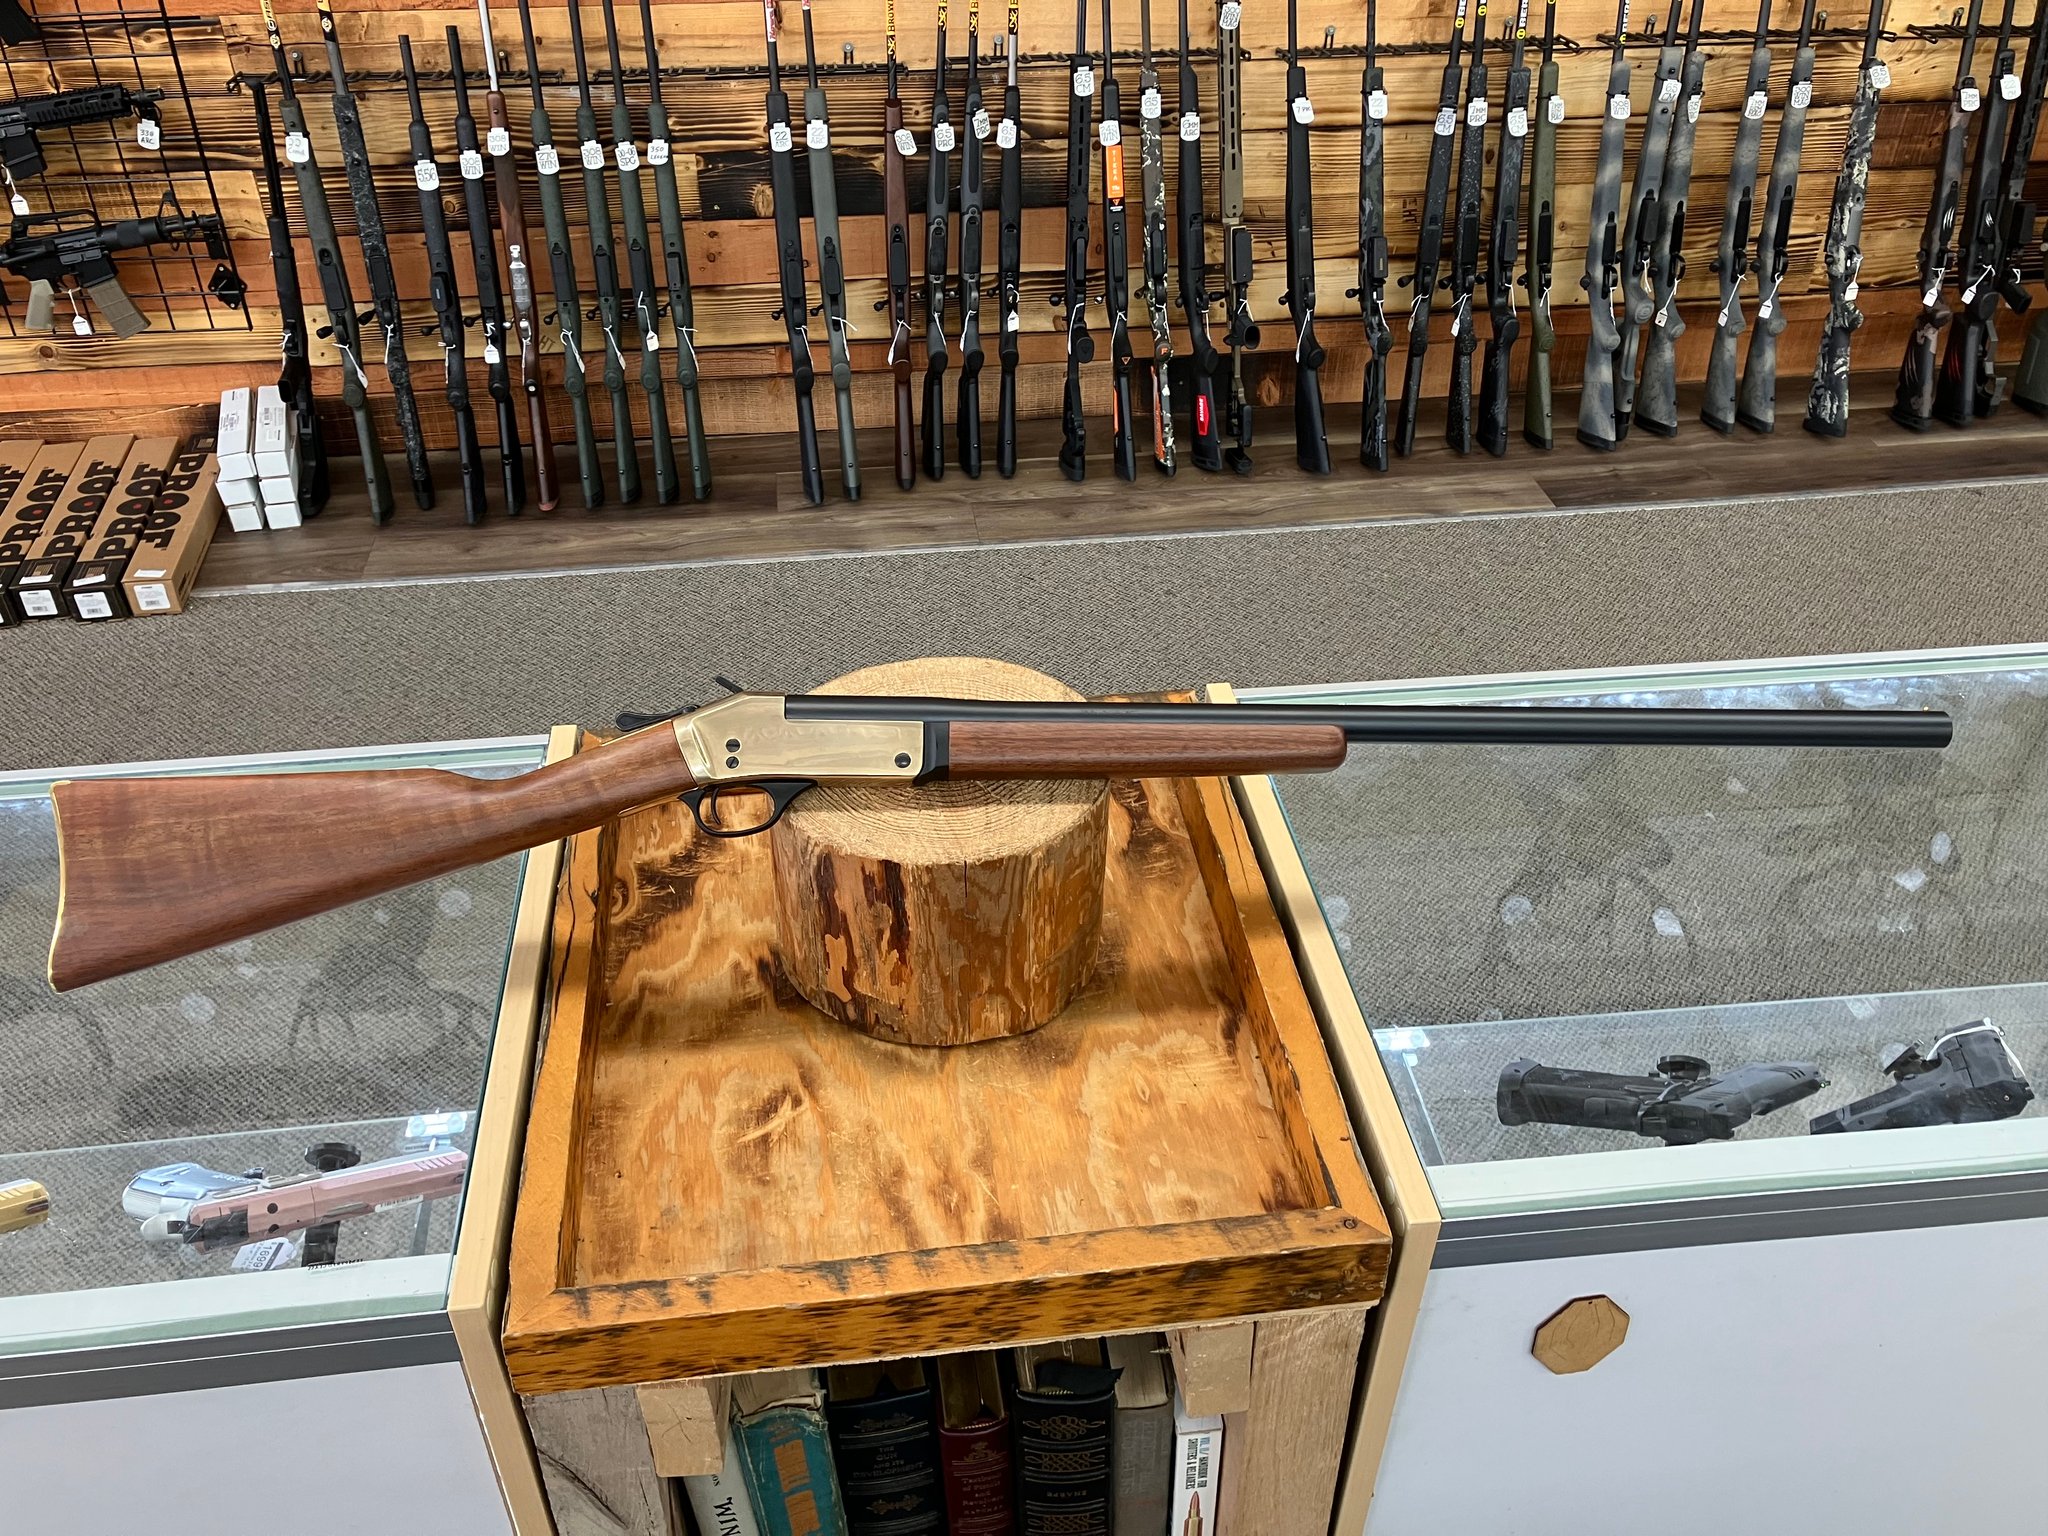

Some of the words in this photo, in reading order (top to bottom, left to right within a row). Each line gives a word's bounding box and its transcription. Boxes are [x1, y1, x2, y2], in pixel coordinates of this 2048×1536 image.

[1076, 84, 1092, 93] CM
[1469, 114, 1487, 123] PRC
[811, 127, 824, 136] 22
[975, 124, 990, 137] PRC
[1183, 129, 1198, 137] ARC
[1436, 124, 1452, 134] CM
[1510, 125, 1526, 135] CM
[489, 134, 507, 143] 308
[774, 131, 788, 140] 22
[810, 136, 825, 144] ARC
[775, 140, 790, 148] ARC
[937, 139, 953, 148] PRC
[1000, 136, 1016, 145] PRC
[489, 143, 507, 152] WIN
[650, 145, 664, 153] 350
[898, 141, 914, 151] WIN
[537, 151, 556, 161] 270
[582, 147, 602, 157] 308
[461, 156, 481, 166] 308
[538, 159, 557, 170] WIN
[583, 156, 603, 166] WIN
[463, 165, 482, 175] WIN
[42, 459, 122, 559] PROOF
[94, 461, 170, 560] PROOF
